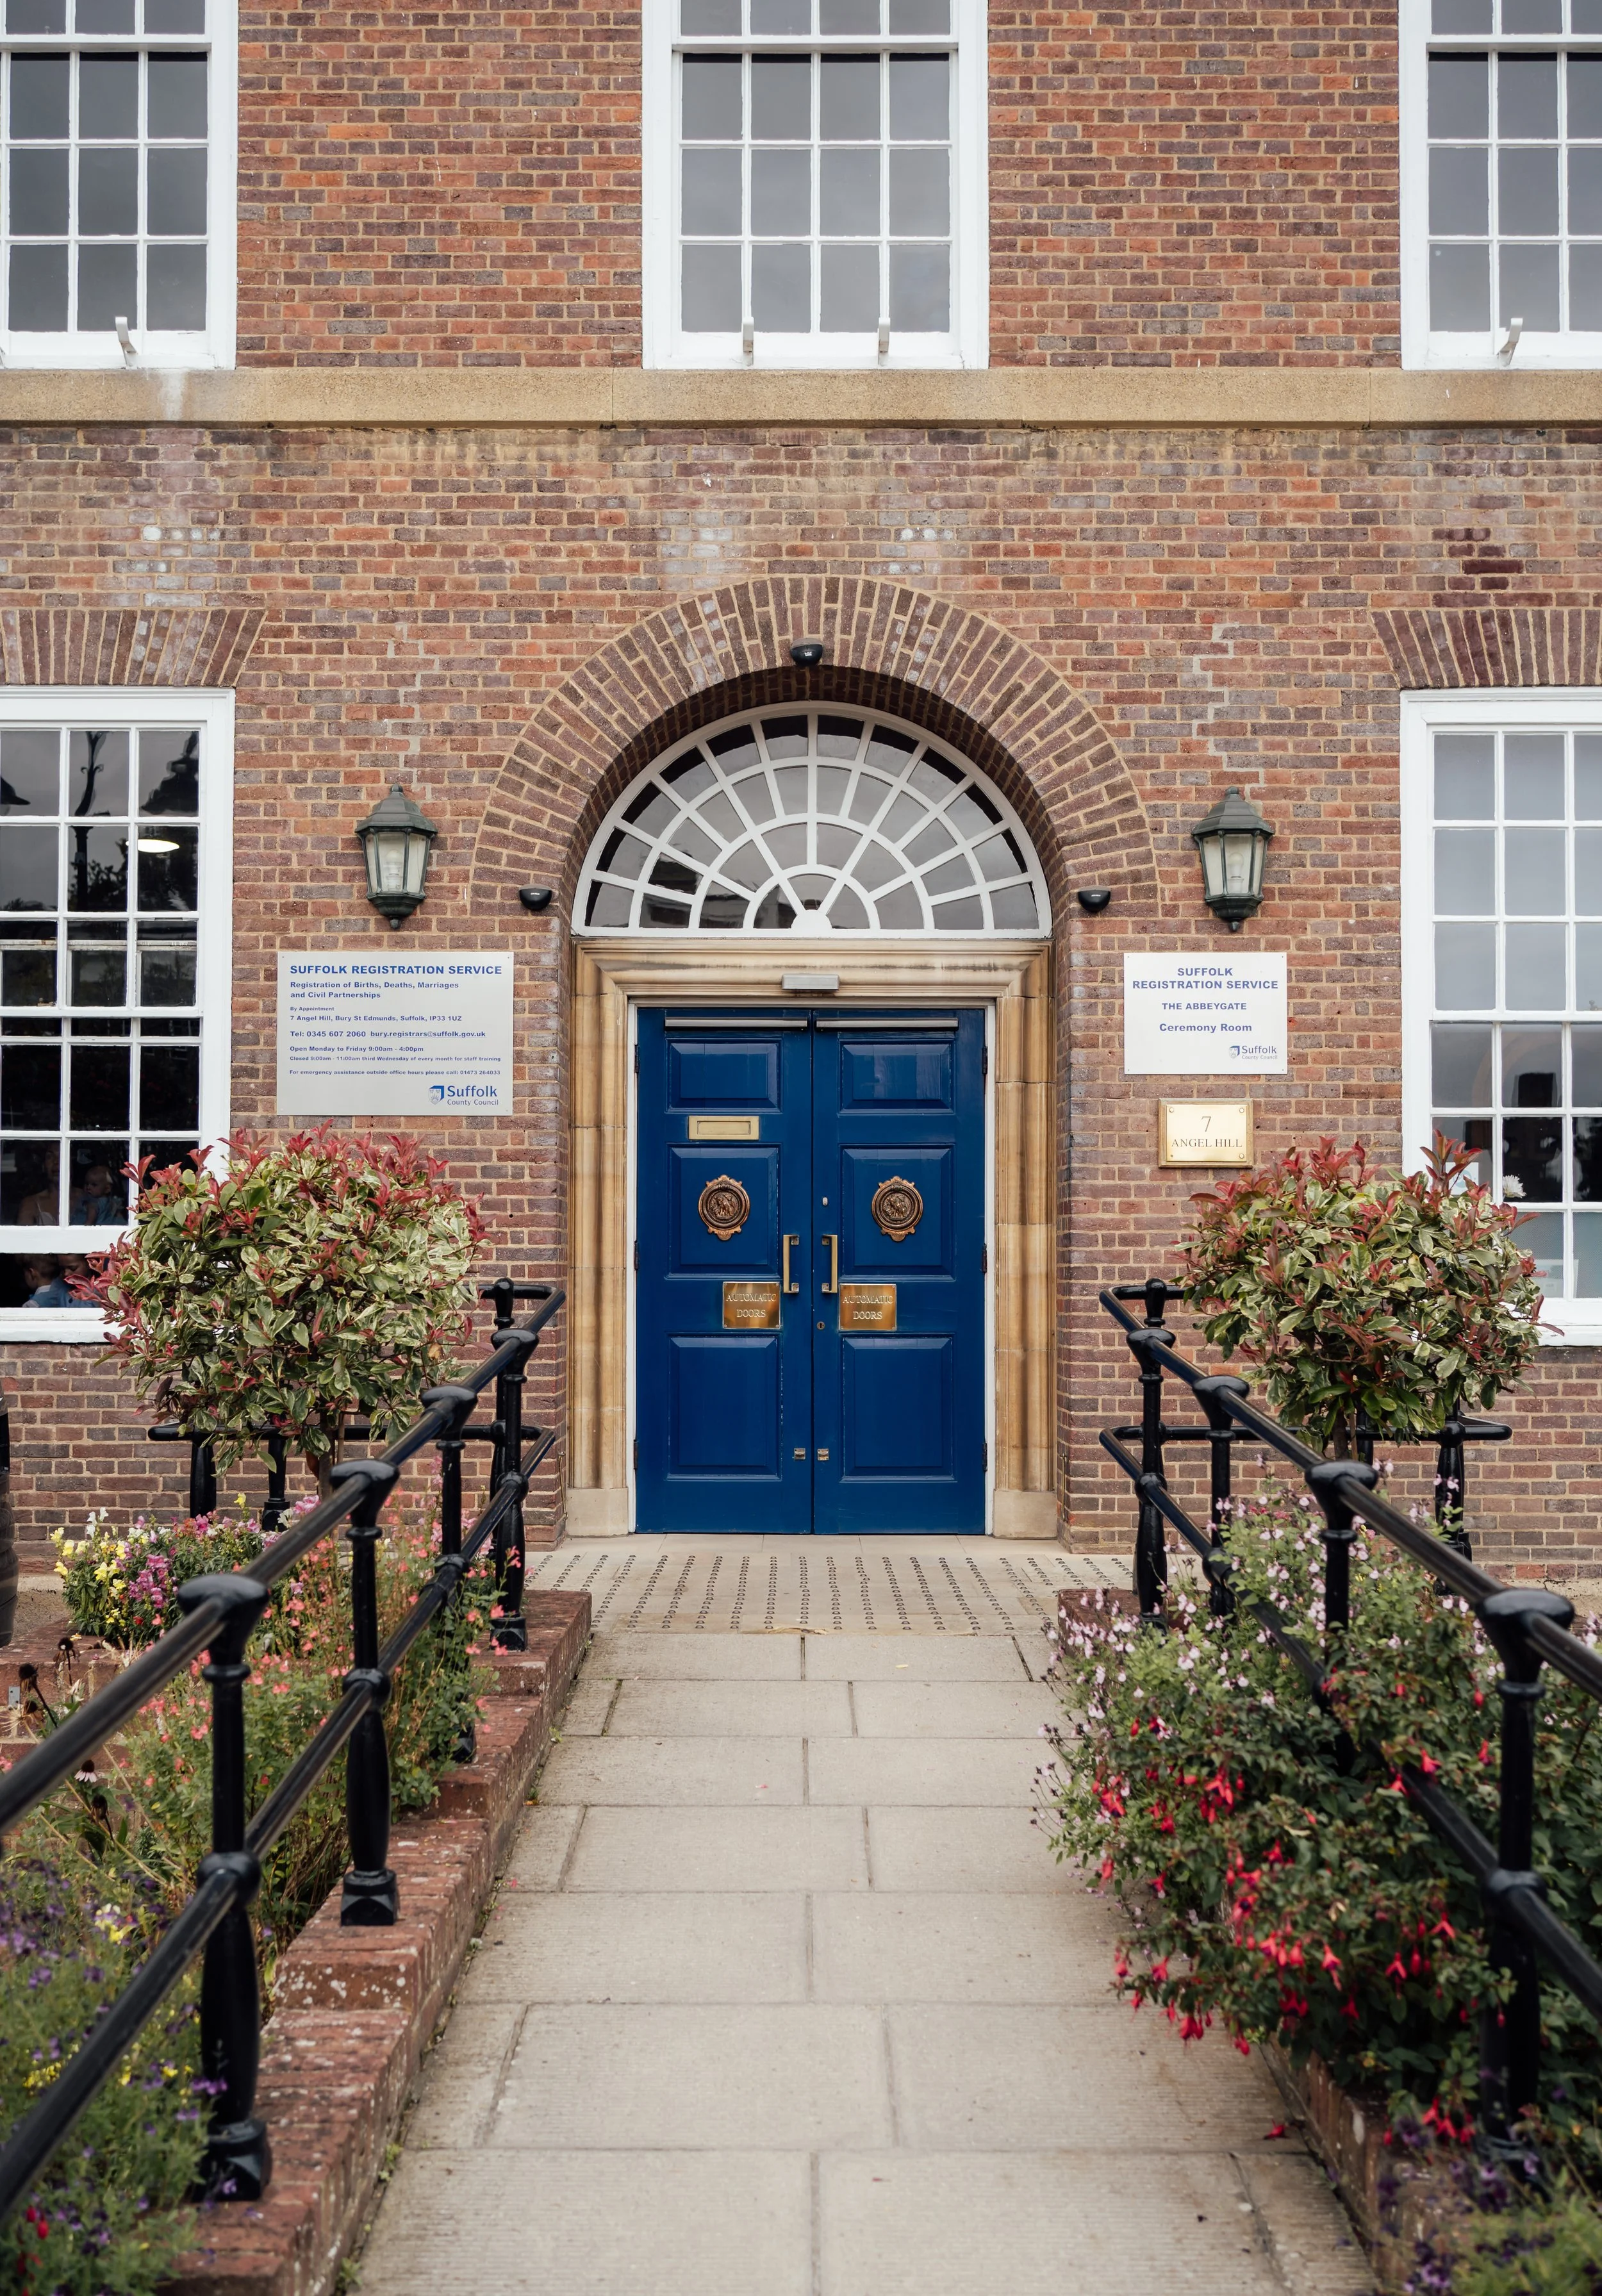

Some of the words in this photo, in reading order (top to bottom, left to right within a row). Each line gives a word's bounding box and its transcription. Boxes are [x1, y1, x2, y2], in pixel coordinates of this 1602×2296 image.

[290, 965, 348, 975] SUFFOLK
[352, 965, 445, 975] REGISTRATION
[449, 966, 502, 975] SERVICE
[1177, 968, 1233, 976] SUFFOLK
[418, 982, 459, 990] Marriages
[1132, 980, 1222, 989] REGISTRATION
[1226, 980, 1278, 989] SERVICE
[1159, 1023, 1216, 1033] Ceremony
[1242, 1045, 1277, 1054] Suffolk
[447, 1085, 497, 1097] Suffolk
[1202, 1116, 1212, 1132] 7
[1172, 1139, 1212, 1148] ANGEL
[1216, 1139, 1243, 1148] HILL
[726, 1293, 777, 1302] AUTOMATIC
[843, 1296, 893, 1304] AUTOMATIC
[737, 1309, 766, 1317] DOORS
[853, 1311, 882, 1320] DOORS
